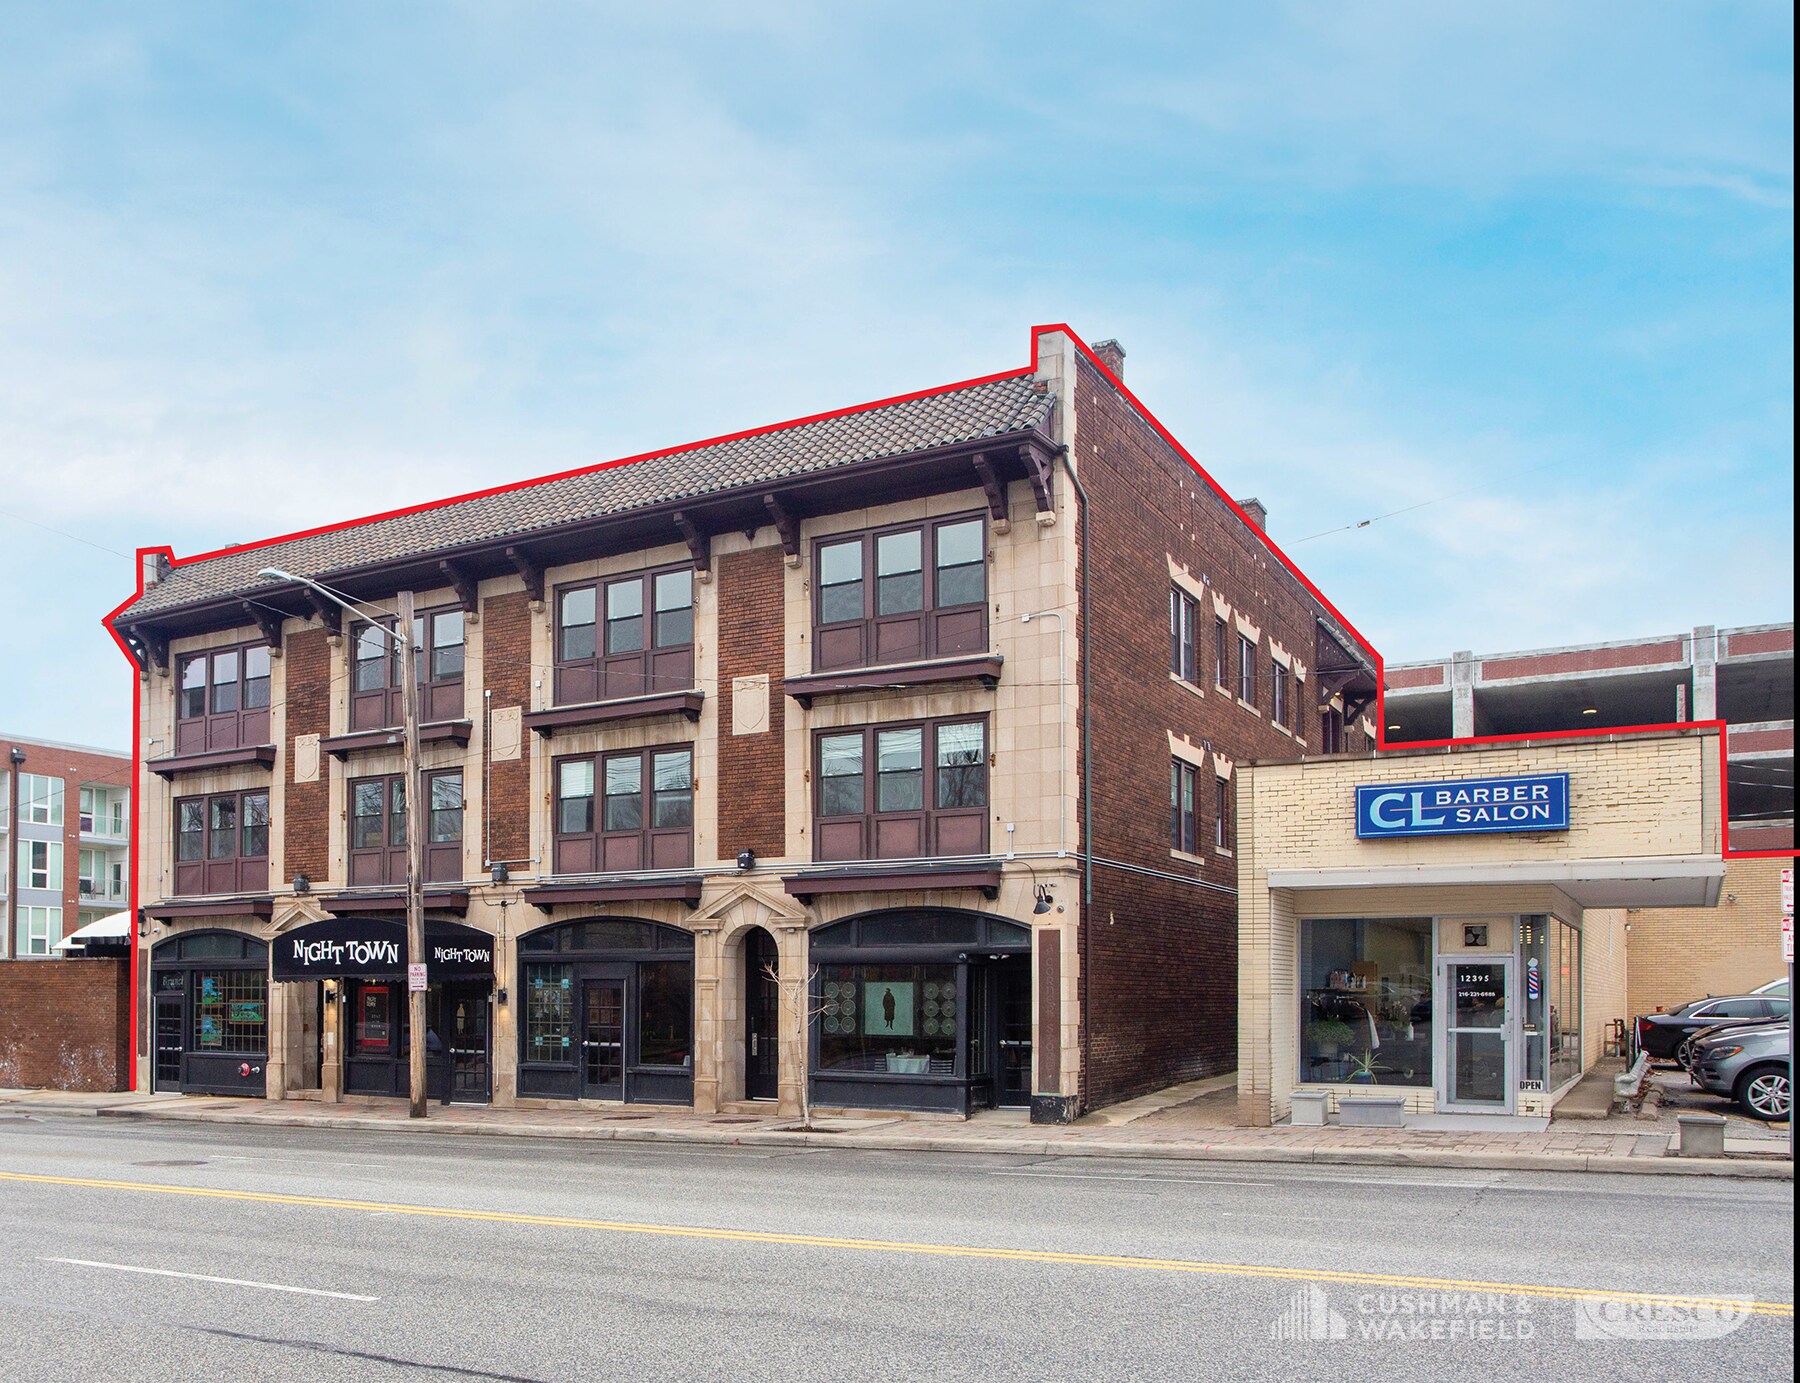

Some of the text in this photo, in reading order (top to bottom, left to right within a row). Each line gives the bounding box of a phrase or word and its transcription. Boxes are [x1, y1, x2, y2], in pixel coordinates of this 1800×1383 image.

[1369, 784, 1549, 829] CL BARBER
[1456, 804, 1550, 823] SALON
[293, 939, 400, 966] NIGHT TOWN
[463, 948, 490, 963] TOWN
[1460, 974, 1489, 982] 12395
[1520, 1081, 1541, 1090] OPEN
